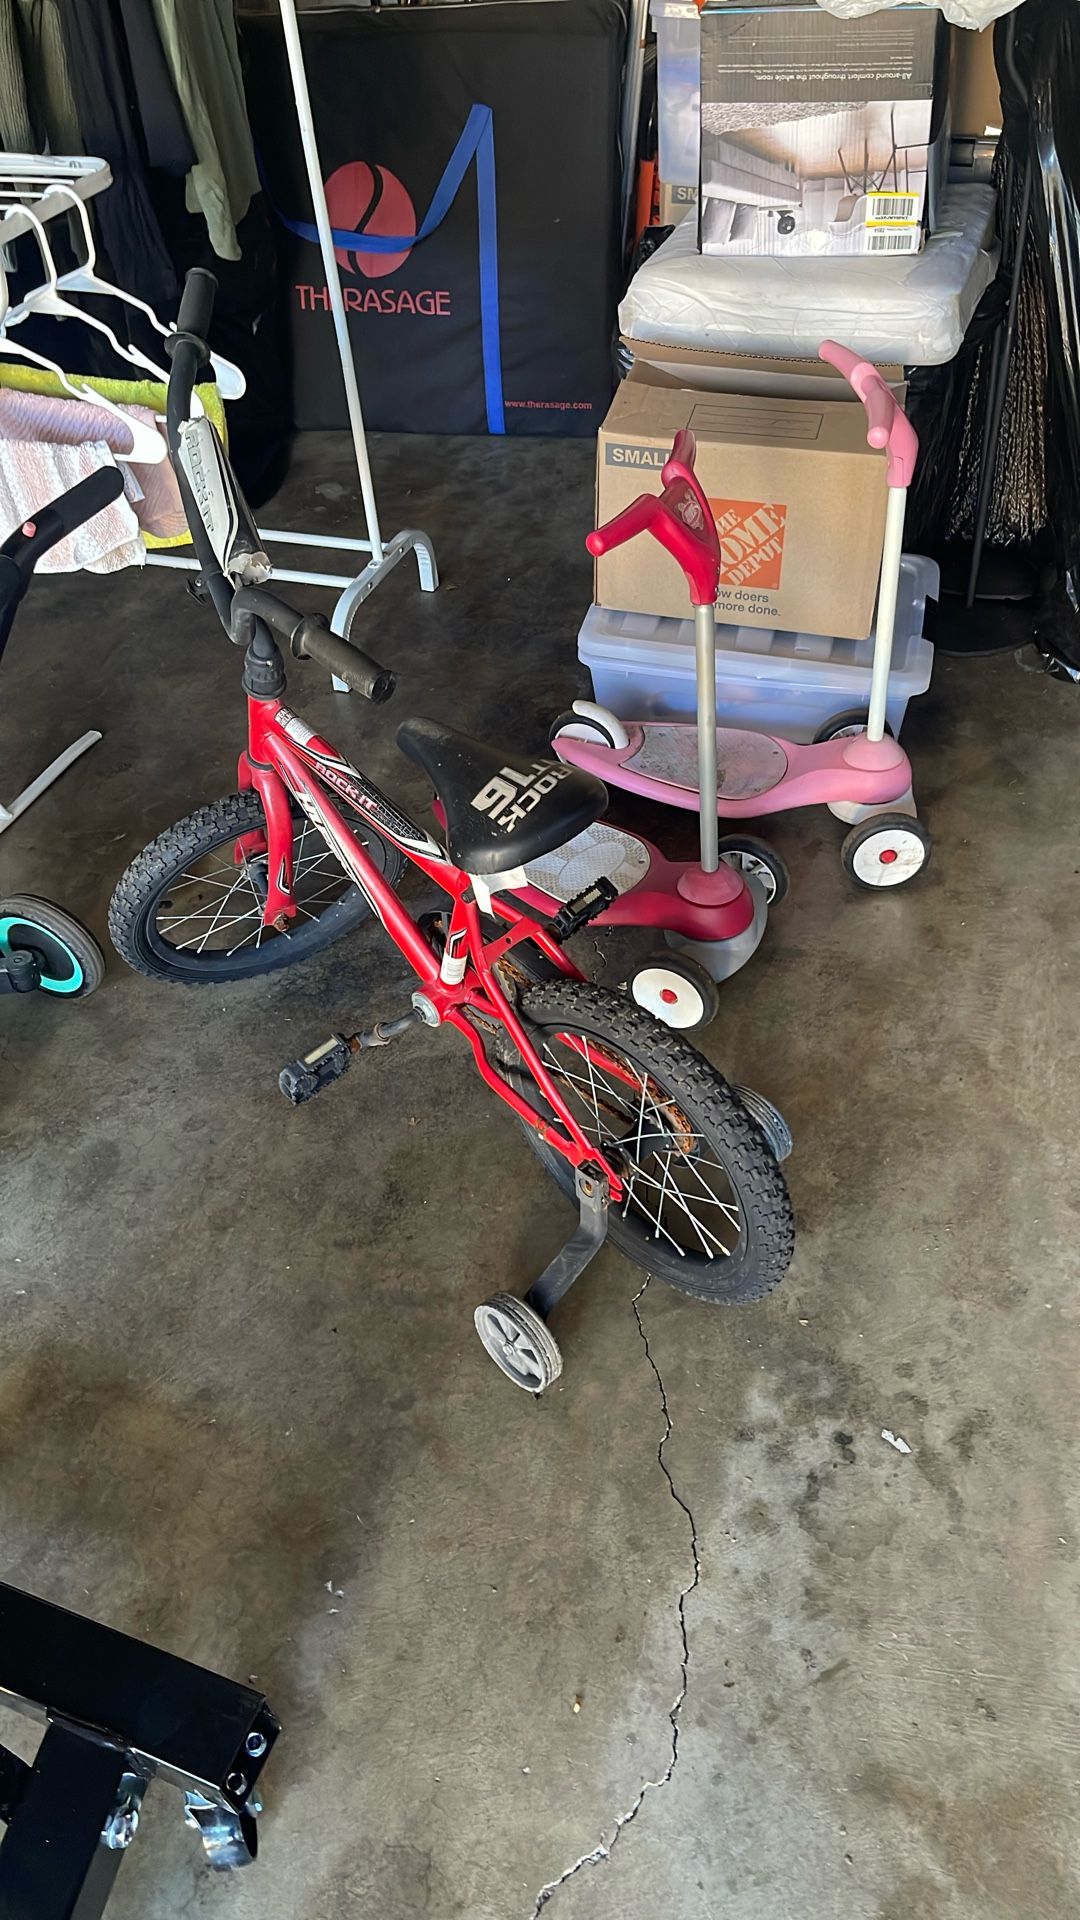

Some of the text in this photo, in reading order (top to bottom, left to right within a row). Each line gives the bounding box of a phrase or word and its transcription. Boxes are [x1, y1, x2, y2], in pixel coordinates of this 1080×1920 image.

[775, 73, 795, 83] whole
[797, 73, 808, 82] the
[809, 72, 847, 82] throughout
[848, 72, 875, 81] comfort
[876, 72, 913, 81] All-around
[295, 285, 451, 316] THRASAGE
[504, 400, 593, 411] www.therasage.com
[184, 429, 214, 505] ROCK
[715, 509, 741, 535] HE
[720, 503, 787, 575] OME
[727, 536, 783, 586] DEPOT
[716, 590, 769, 603] ow doers
[714, 601, 781, 617] more done.
[315, 761, 380, 813] ROCK IT
[470, 759, 557, 820] IT 16
[497, 765, 574, 833] ROCK
